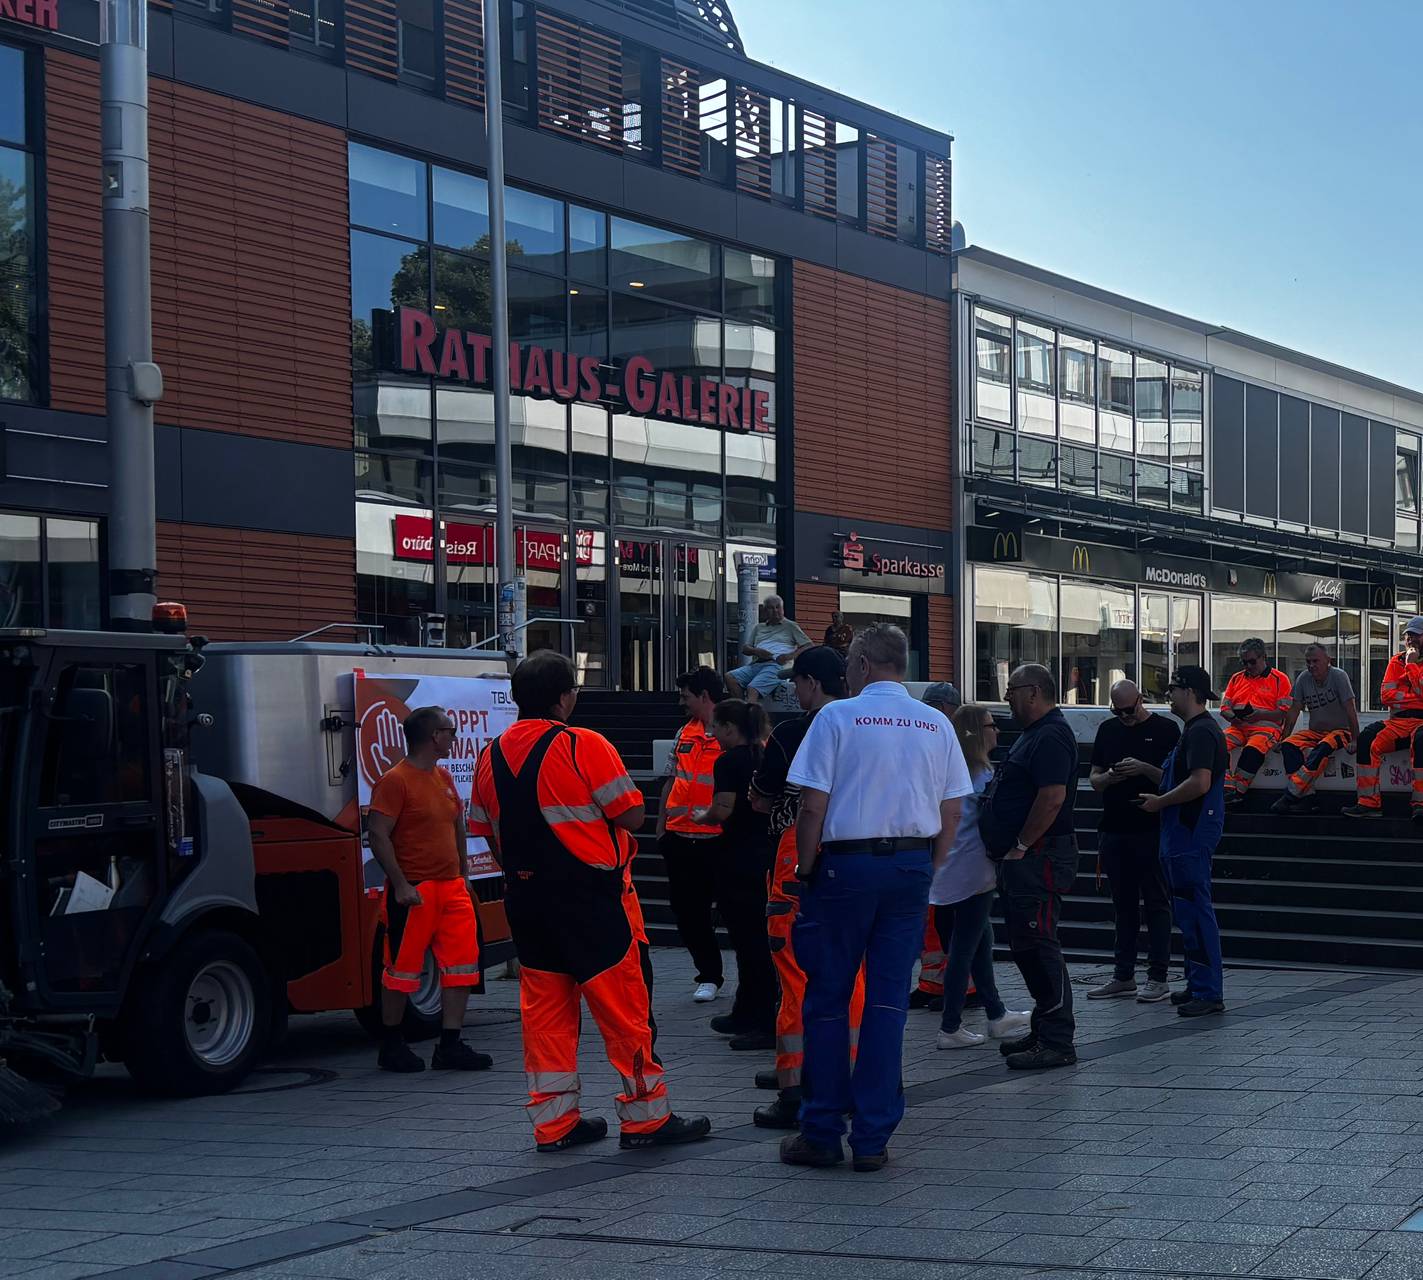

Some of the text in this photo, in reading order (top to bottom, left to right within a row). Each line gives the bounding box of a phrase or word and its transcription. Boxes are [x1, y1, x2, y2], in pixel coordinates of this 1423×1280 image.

[872, 553, 945, 578] Sparkasse
[1146, 566, 1207, 588] McDonald's
[447, 709, 489, 733] OPPT
[855, 717, 938, 732] KOMM ZU UNS!
[451, 761, 474, 773] BESCHÄ
